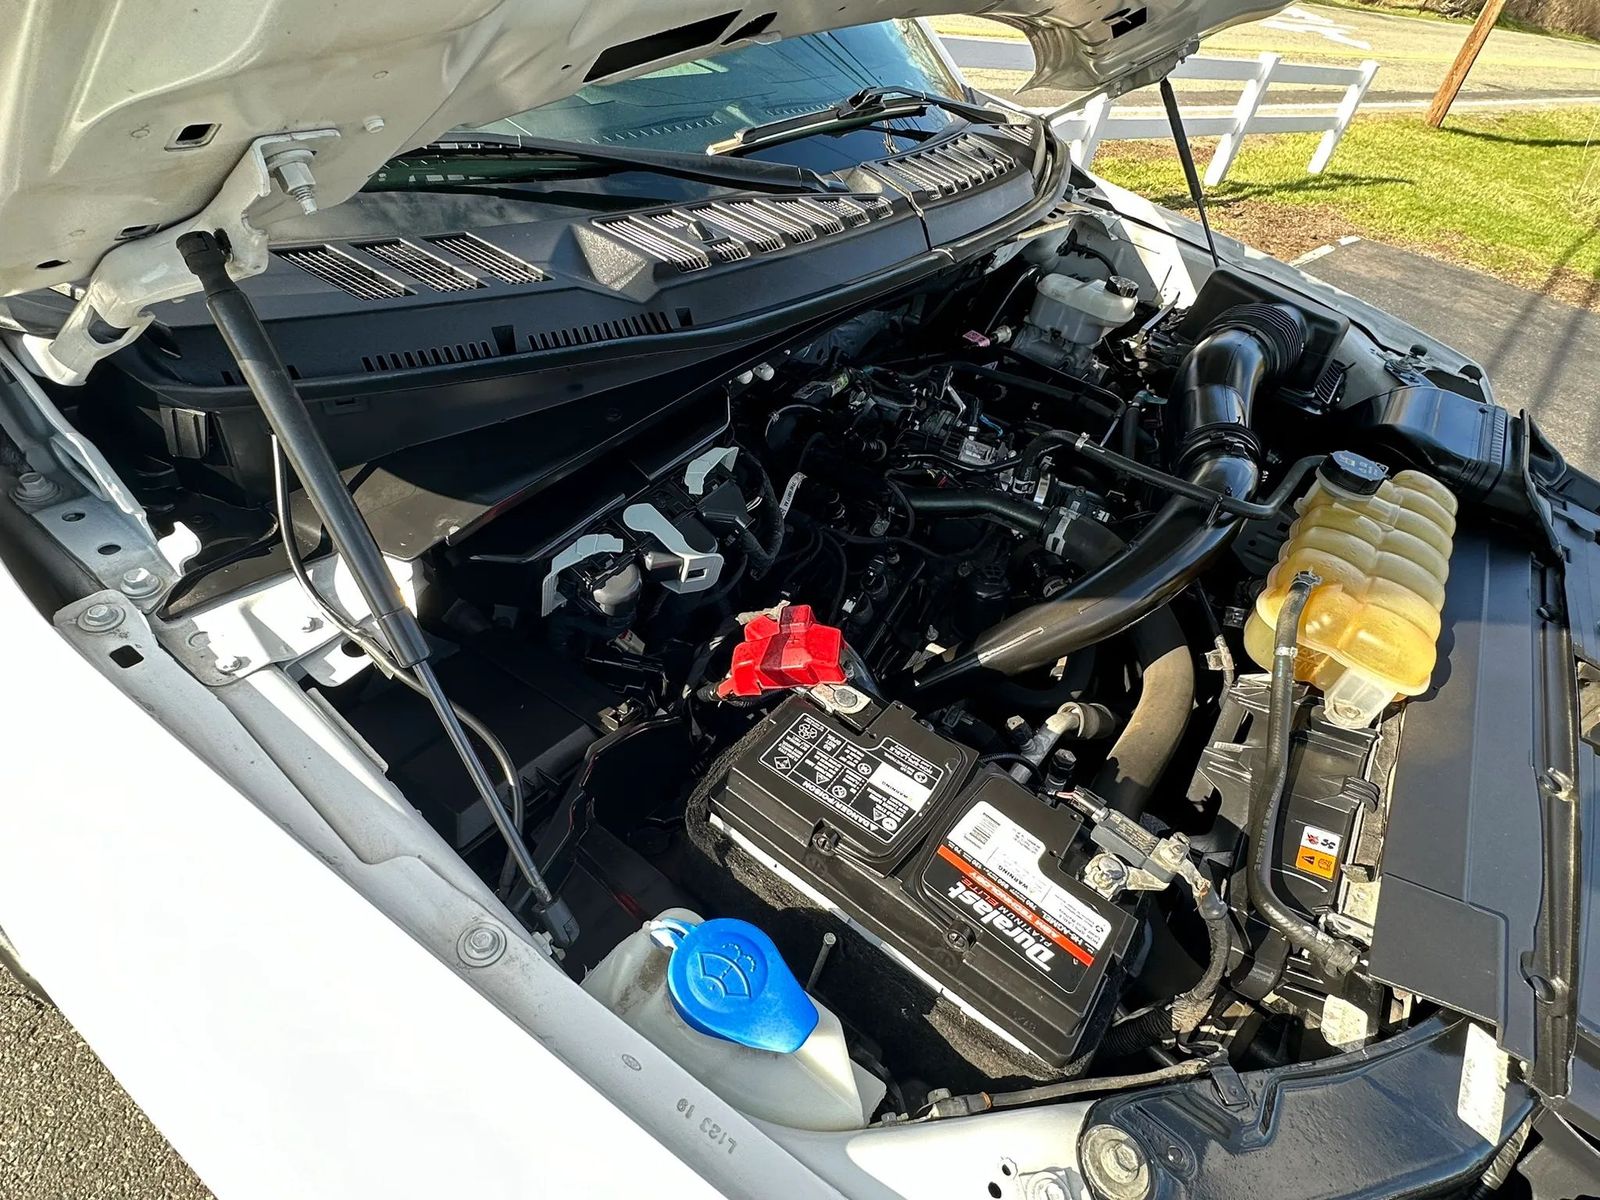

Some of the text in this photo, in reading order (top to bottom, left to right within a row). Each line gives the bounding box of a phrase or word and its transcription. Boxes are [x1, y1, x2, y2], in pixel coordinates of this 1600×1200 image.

[801, 780, 871, 826] DANGER/POISON
[969, 871, 1034, 919] TECHNOLOGY
[998, 865, 1029, 890] WARNING
[948, 881, 1055, 972] Duralast
[998, 906, 1052, 946] PLATINUM
